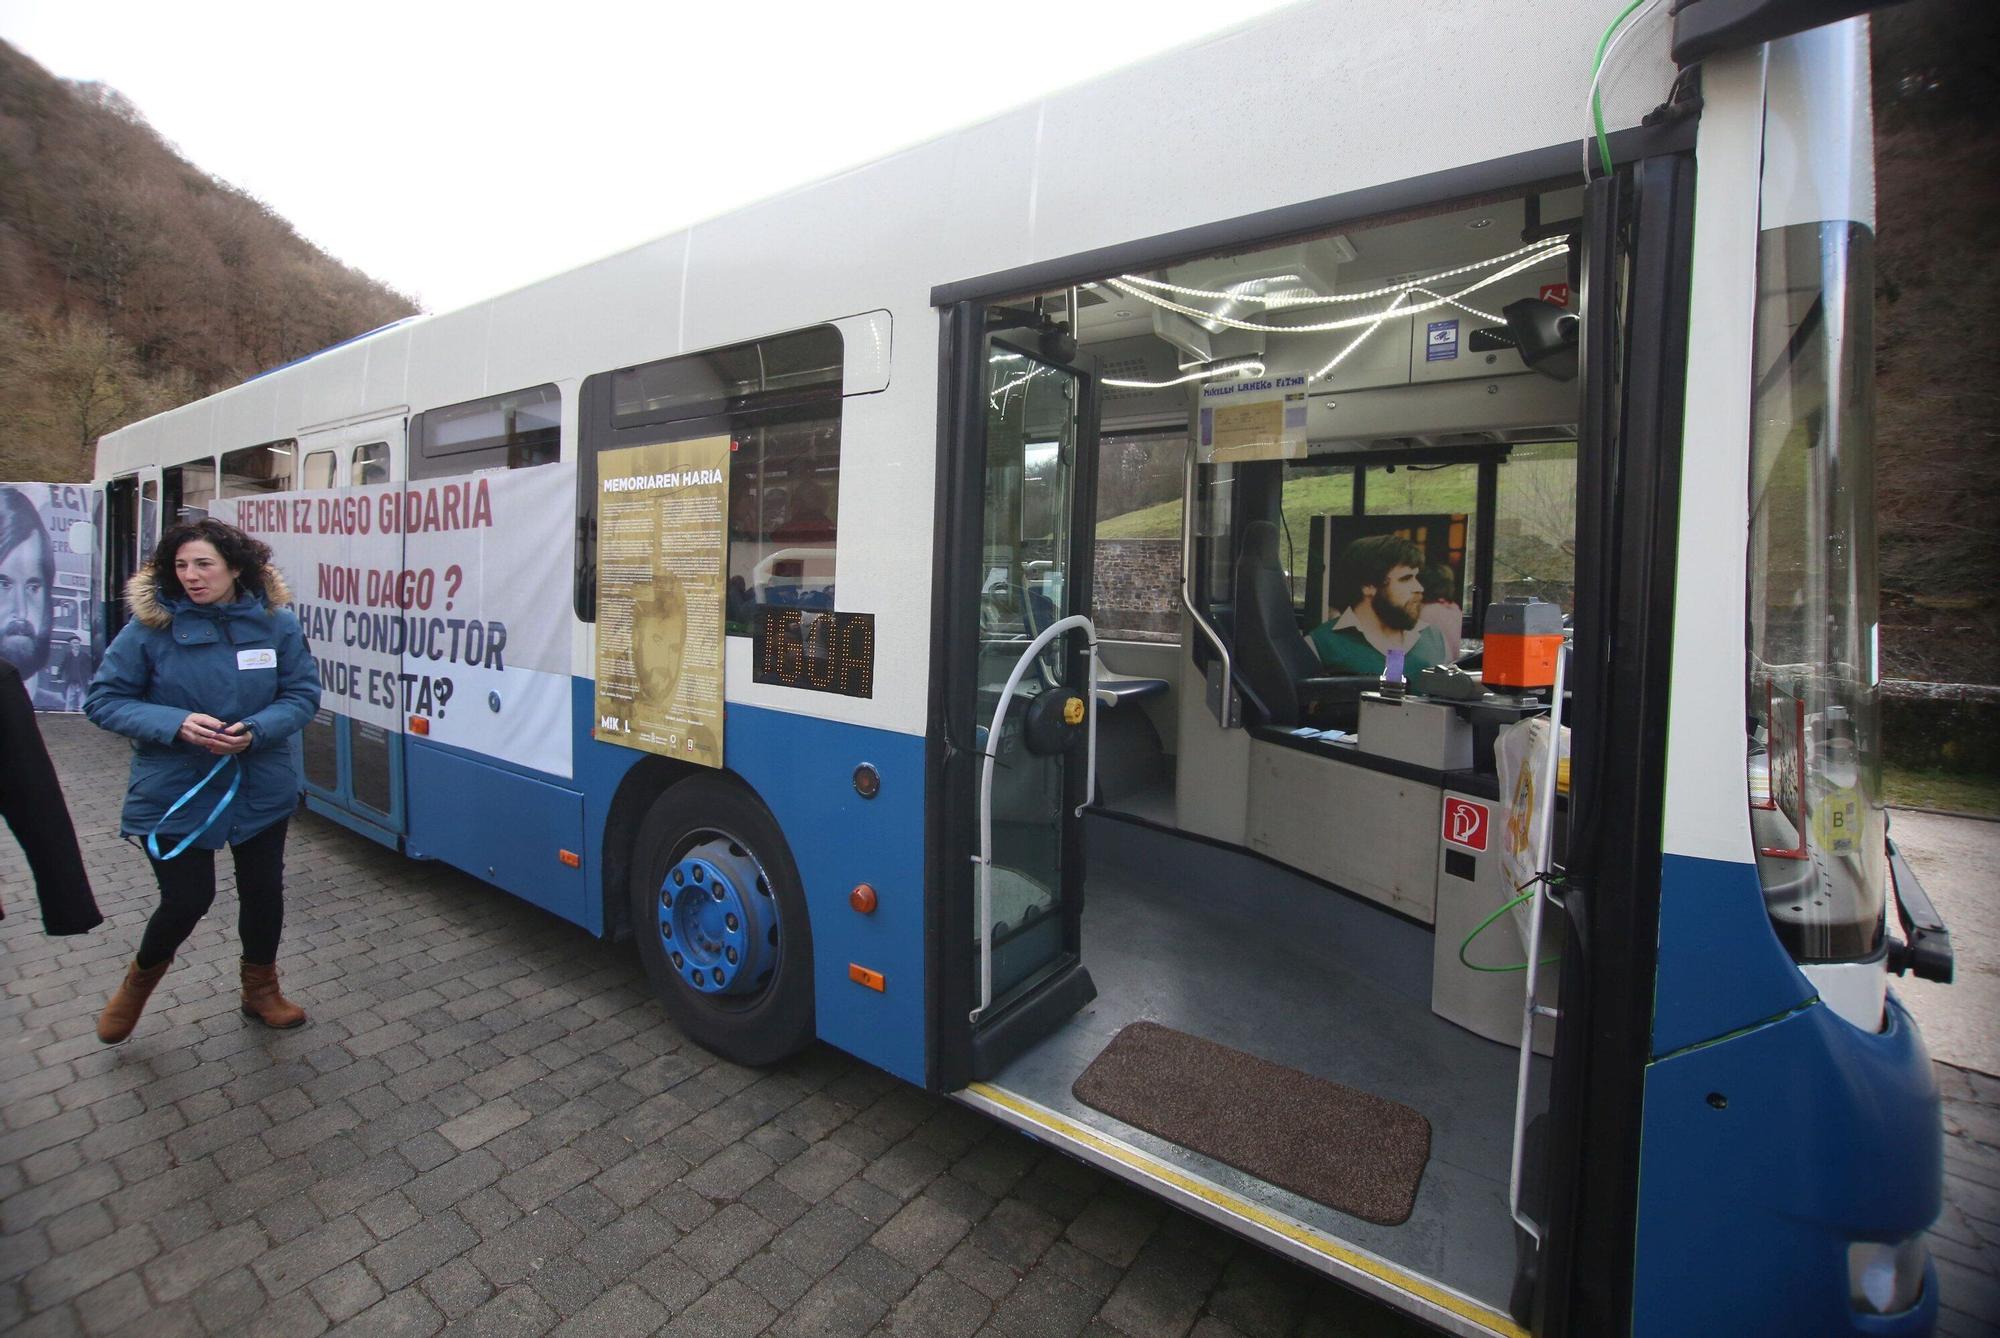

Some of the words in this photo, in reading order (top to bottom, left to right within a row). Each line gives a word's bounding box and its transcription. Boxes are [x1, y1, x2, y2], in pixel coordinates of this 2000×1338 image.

[603, 472, 680, 493] MEMORIAREN
[682, 468, 723, 487] HARIA
[237, 499, 287, 533] HEMEN
[293, 498, 312, 534] EZ
[318, 495, 371, 536] DAGO
[378, 478, 493, 535] GIDARIA
[318, 562, 361, 606] NON
[366, 568, 435, 612] DAGO
[444, 564, 463, 612] ?
[299, 603, 337, 642] HAY
[344, 610, 507, 671] CONDUCTOR
[311, 655, 362, 701] NDE
[1833, 812, 1844, 827] B
